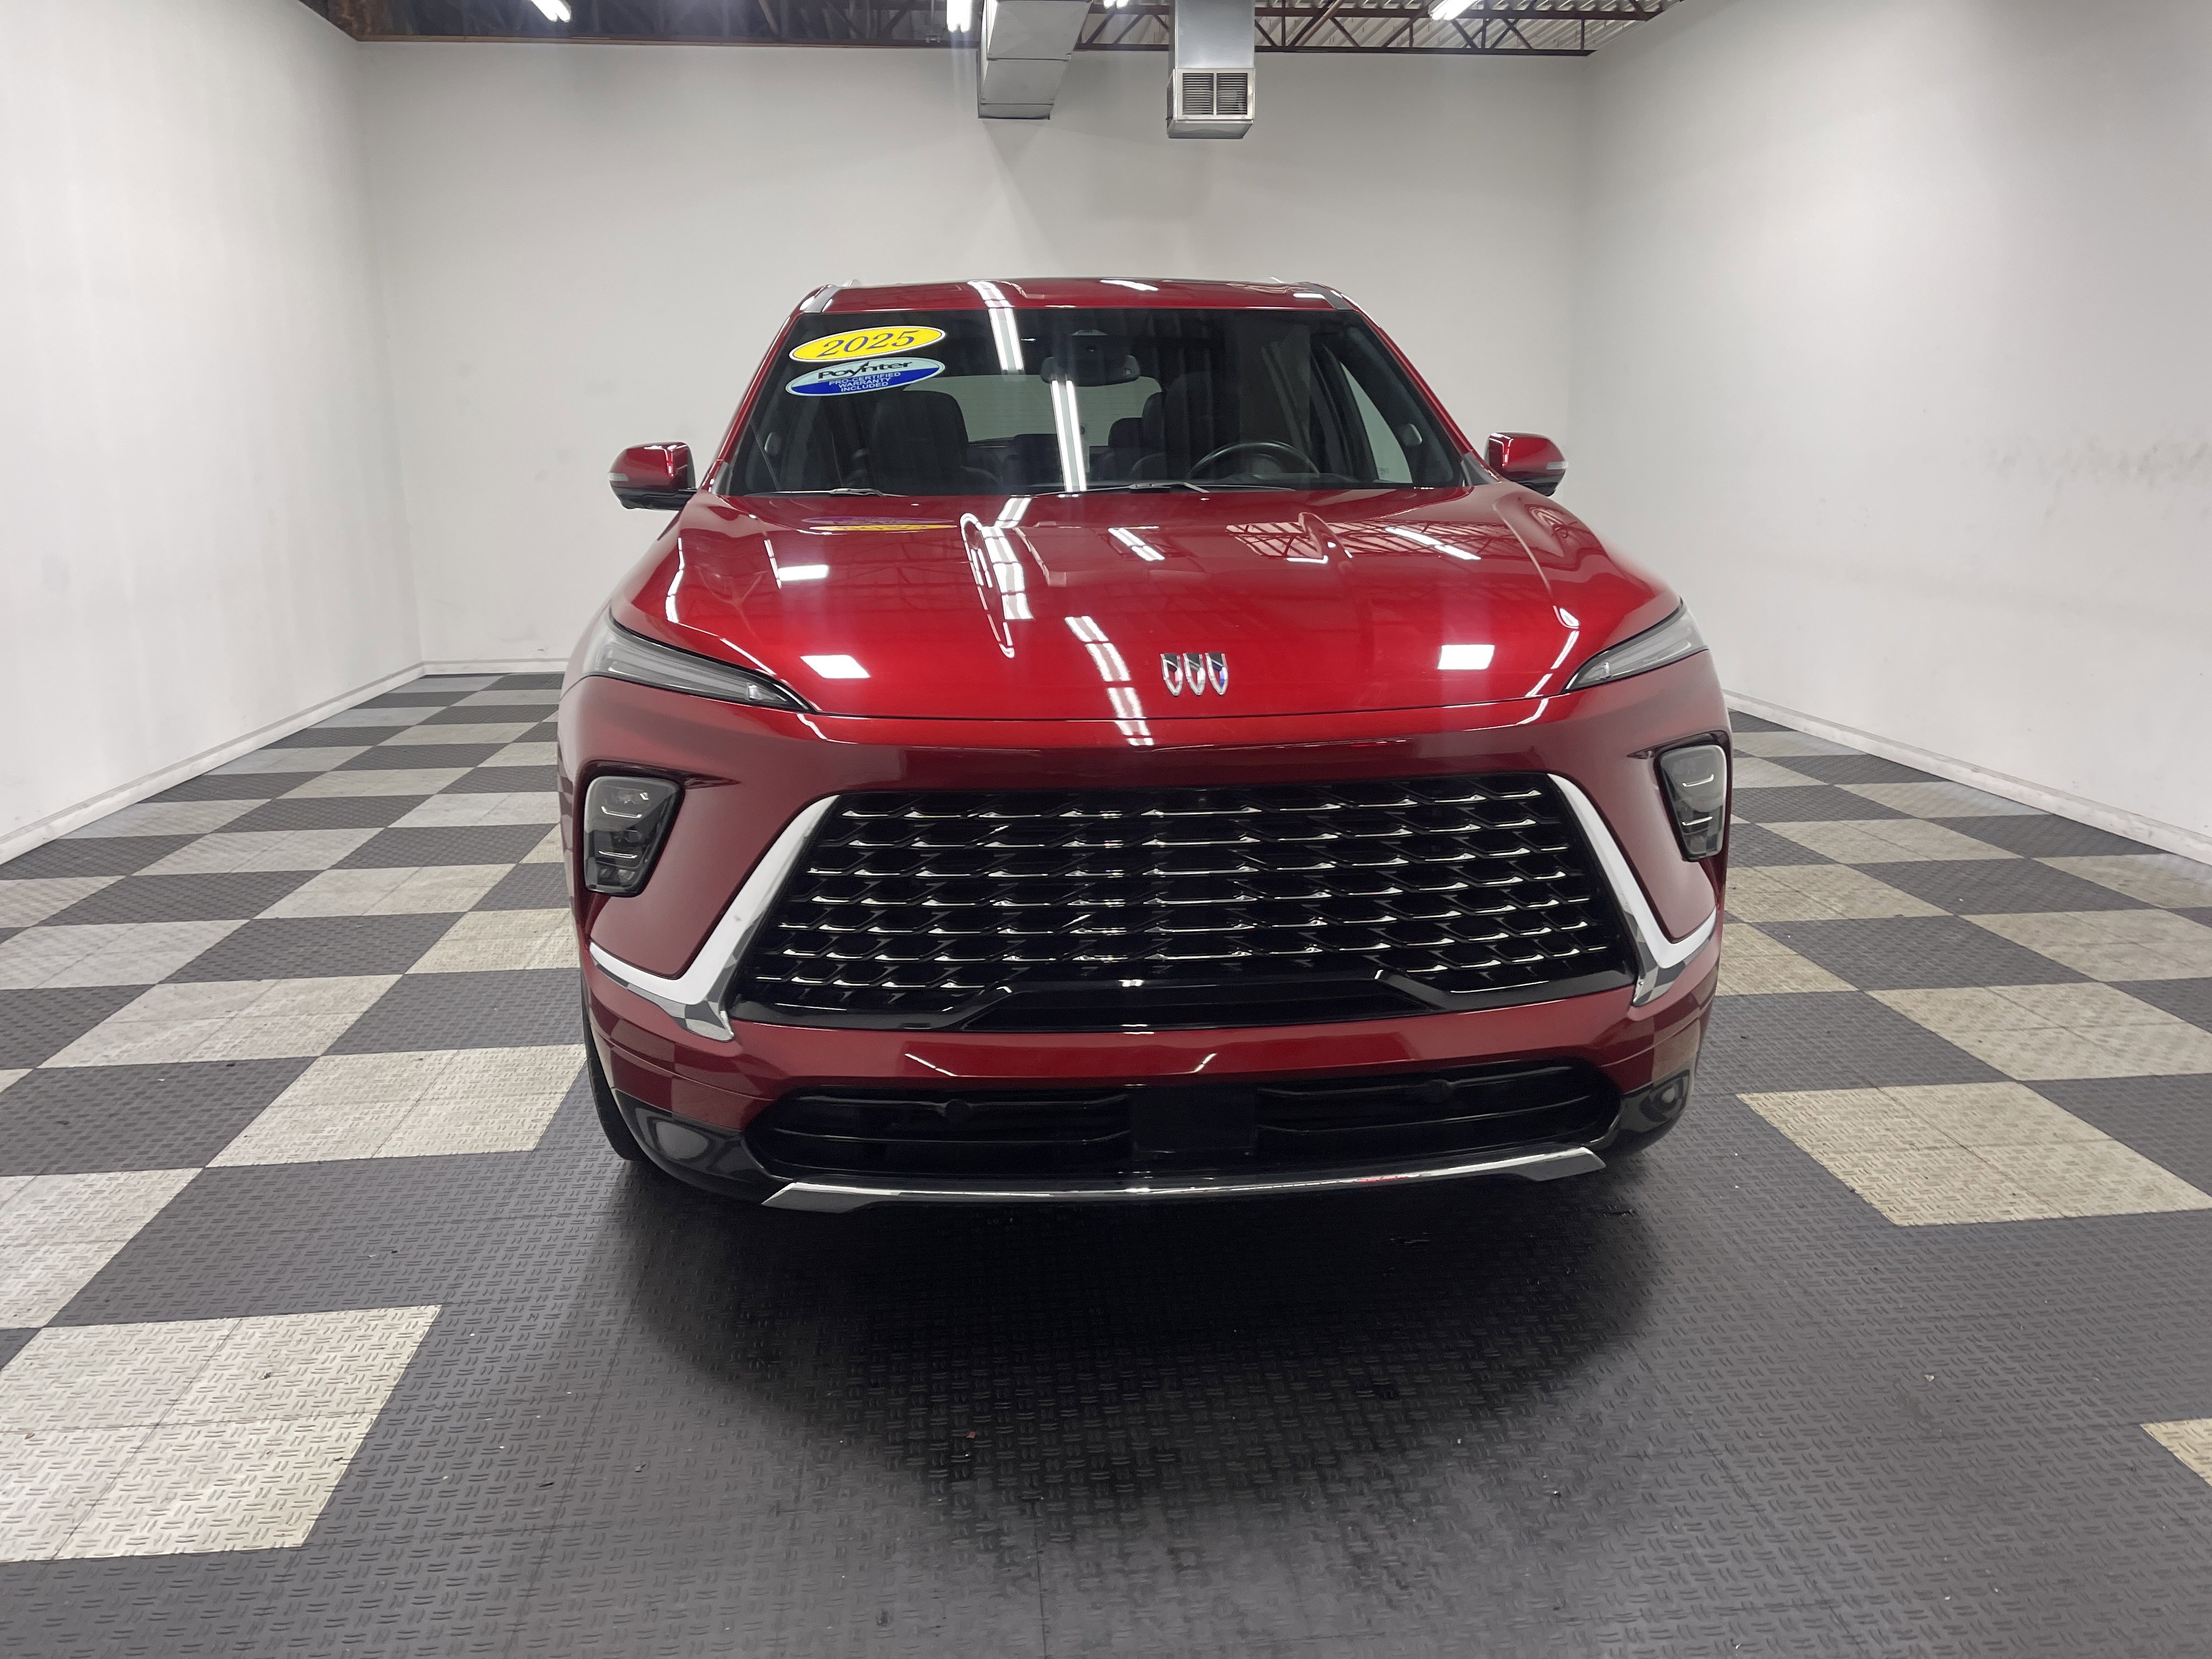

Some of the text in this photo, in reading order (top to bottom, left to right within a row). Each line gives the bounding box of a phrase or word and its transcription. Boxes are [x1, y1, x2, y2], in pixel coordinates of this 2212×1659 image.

[816, 330, 919, 357] 2025
[818, 361, 912, 379] Poynter
[828, 372, 901, 386] PRO-CERTIFIED
[838, 377, 891, 388] WARRANTY
[840, 382, 888, 392] INCLUDED
